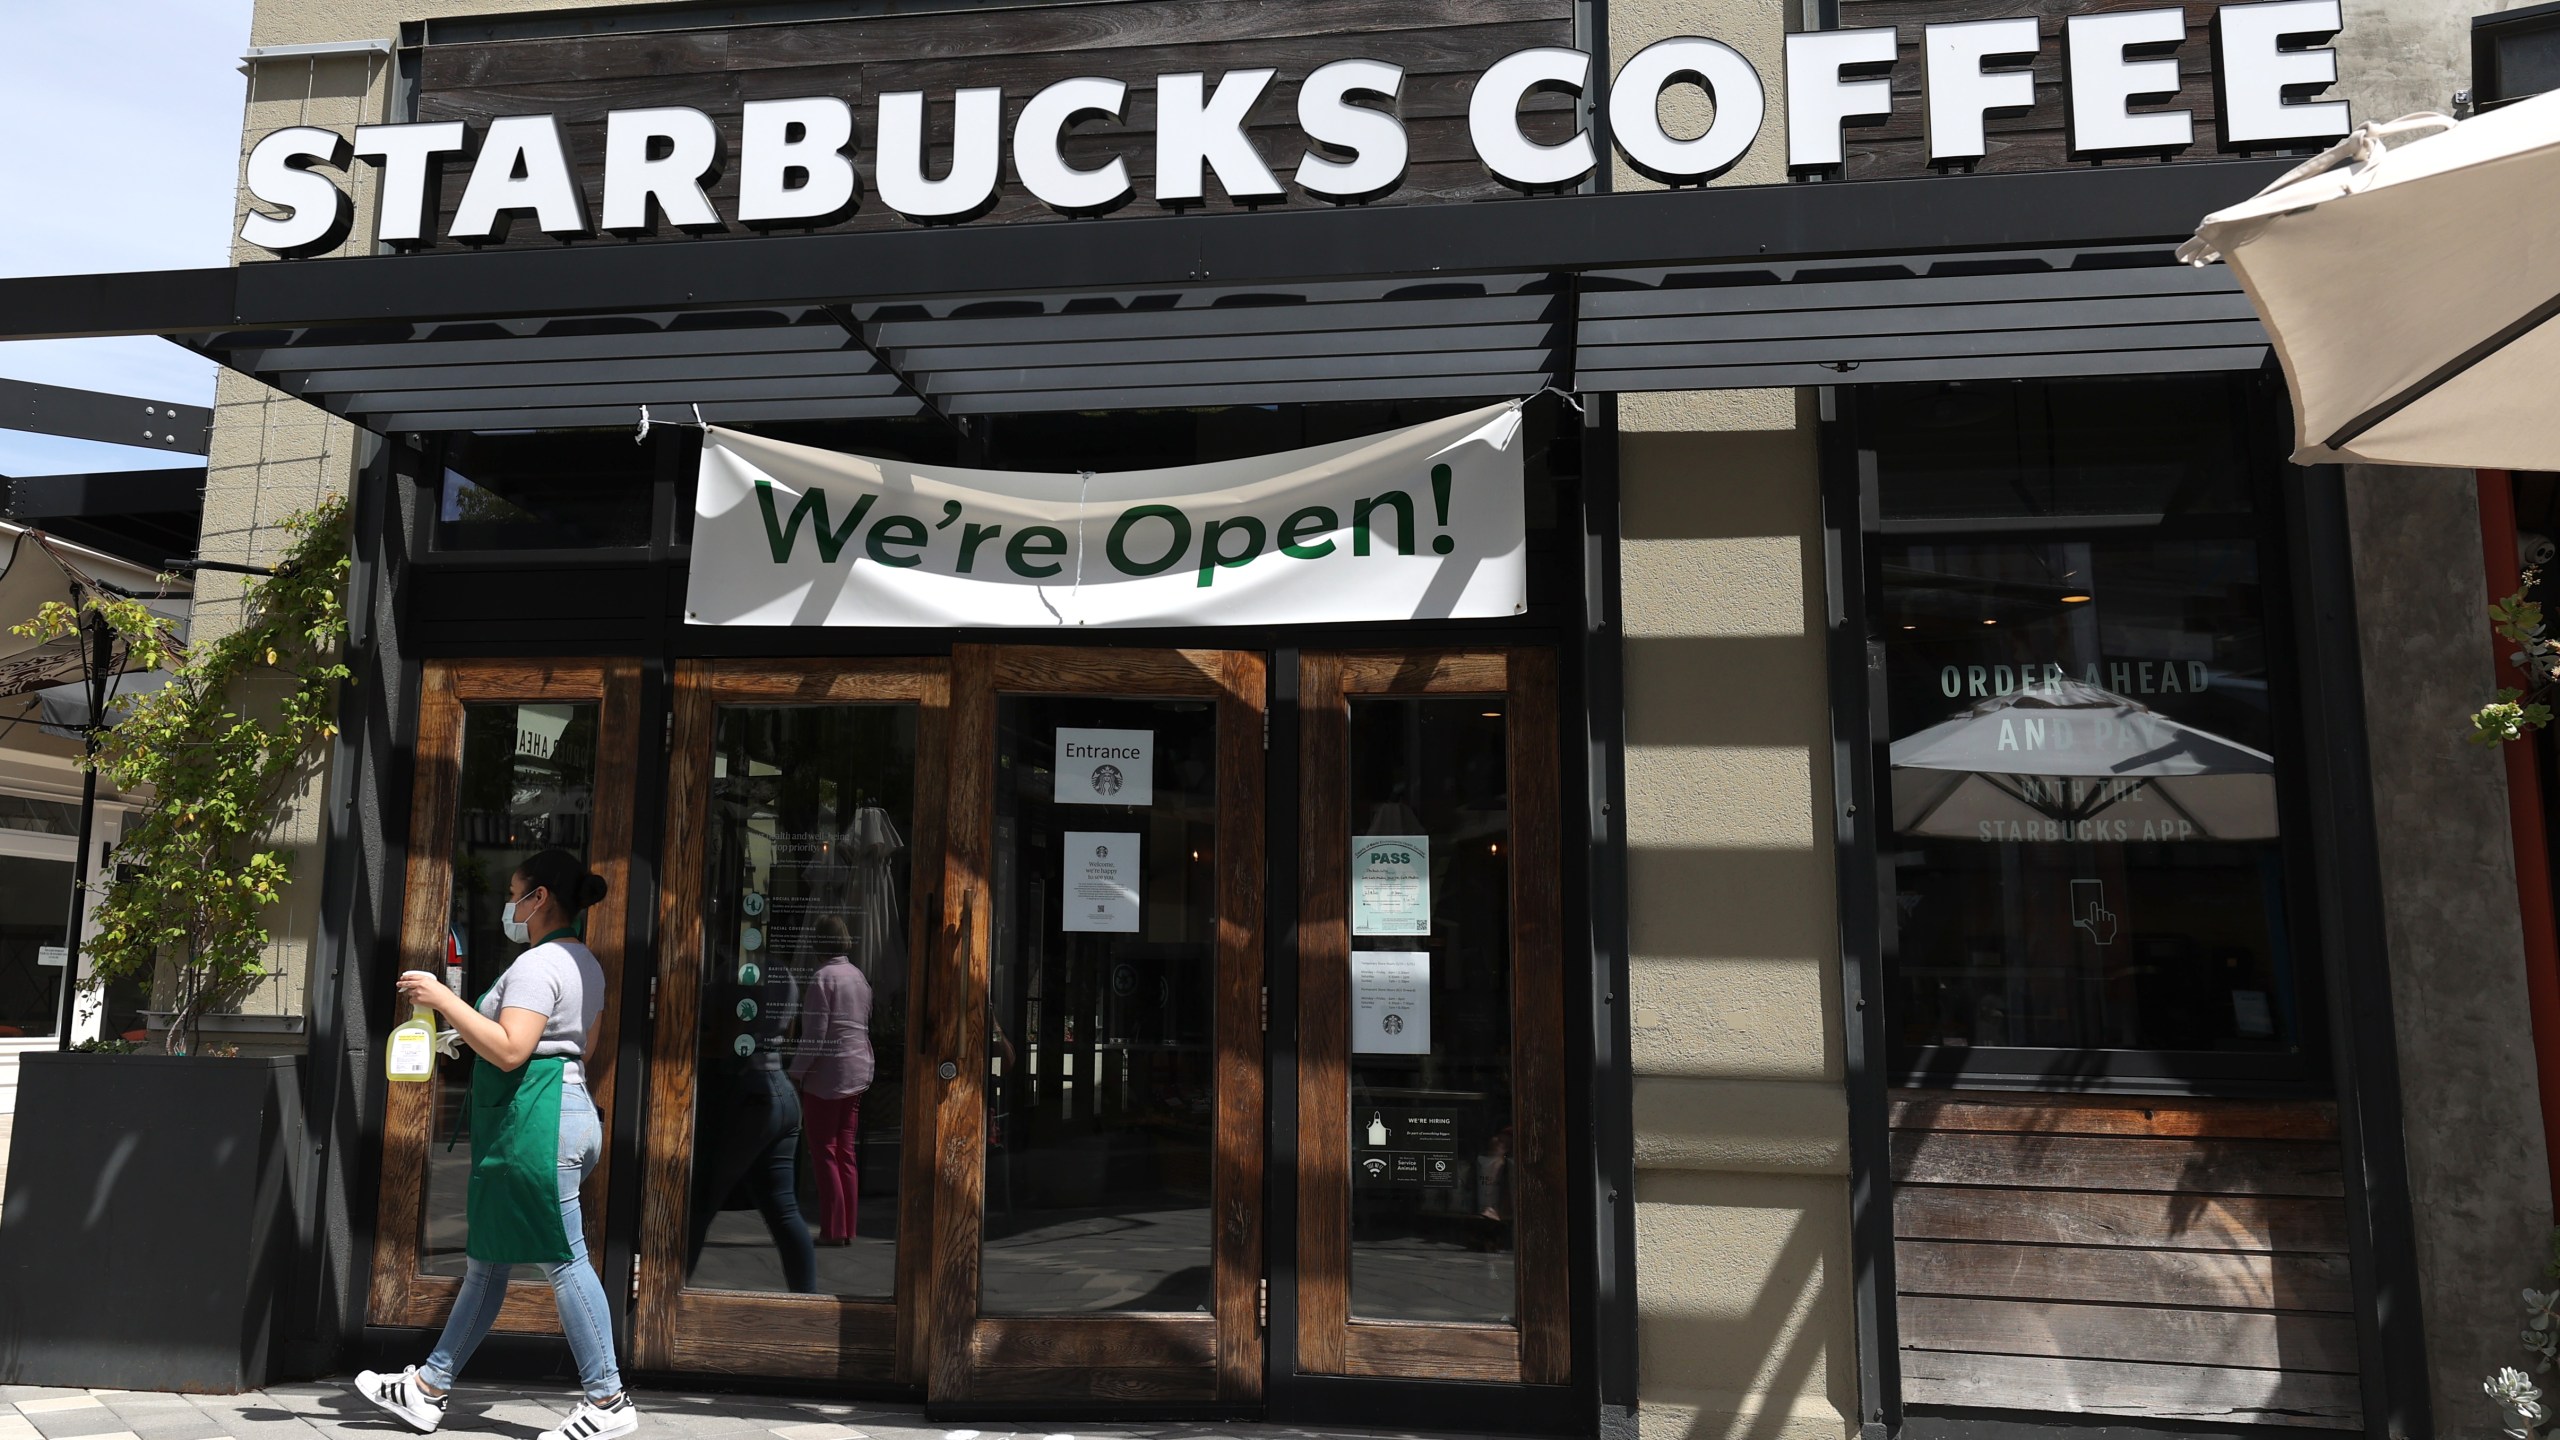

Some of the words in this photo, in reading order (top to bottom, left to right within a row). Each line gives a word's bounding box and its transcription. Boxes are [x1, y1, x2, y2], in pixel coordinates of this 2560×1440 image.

[239, 57, 1409, 255] STARBUCKS
[1468, 0, 2352, 188] COFFEE
[754, 479, 1069, 580] We're
[1105, 463, 1458, 588] Open!
[1941, 661, 2065, 697] ORDER
[2083, 660, 2209, 695] AHEAD
[1997, 717, 2073, 751] AND
[2094, 716, 2158, 749] PAY
[1066, 743, 1140, 760] Entrance
[2021, 780, 2085, 804] WITH
[2097, 780, 2143, 803] THE
[792, 832, 807, 841] and
[2142, 818, 2192, 842] APP
[1371, 852, 1410, 864] PASS
